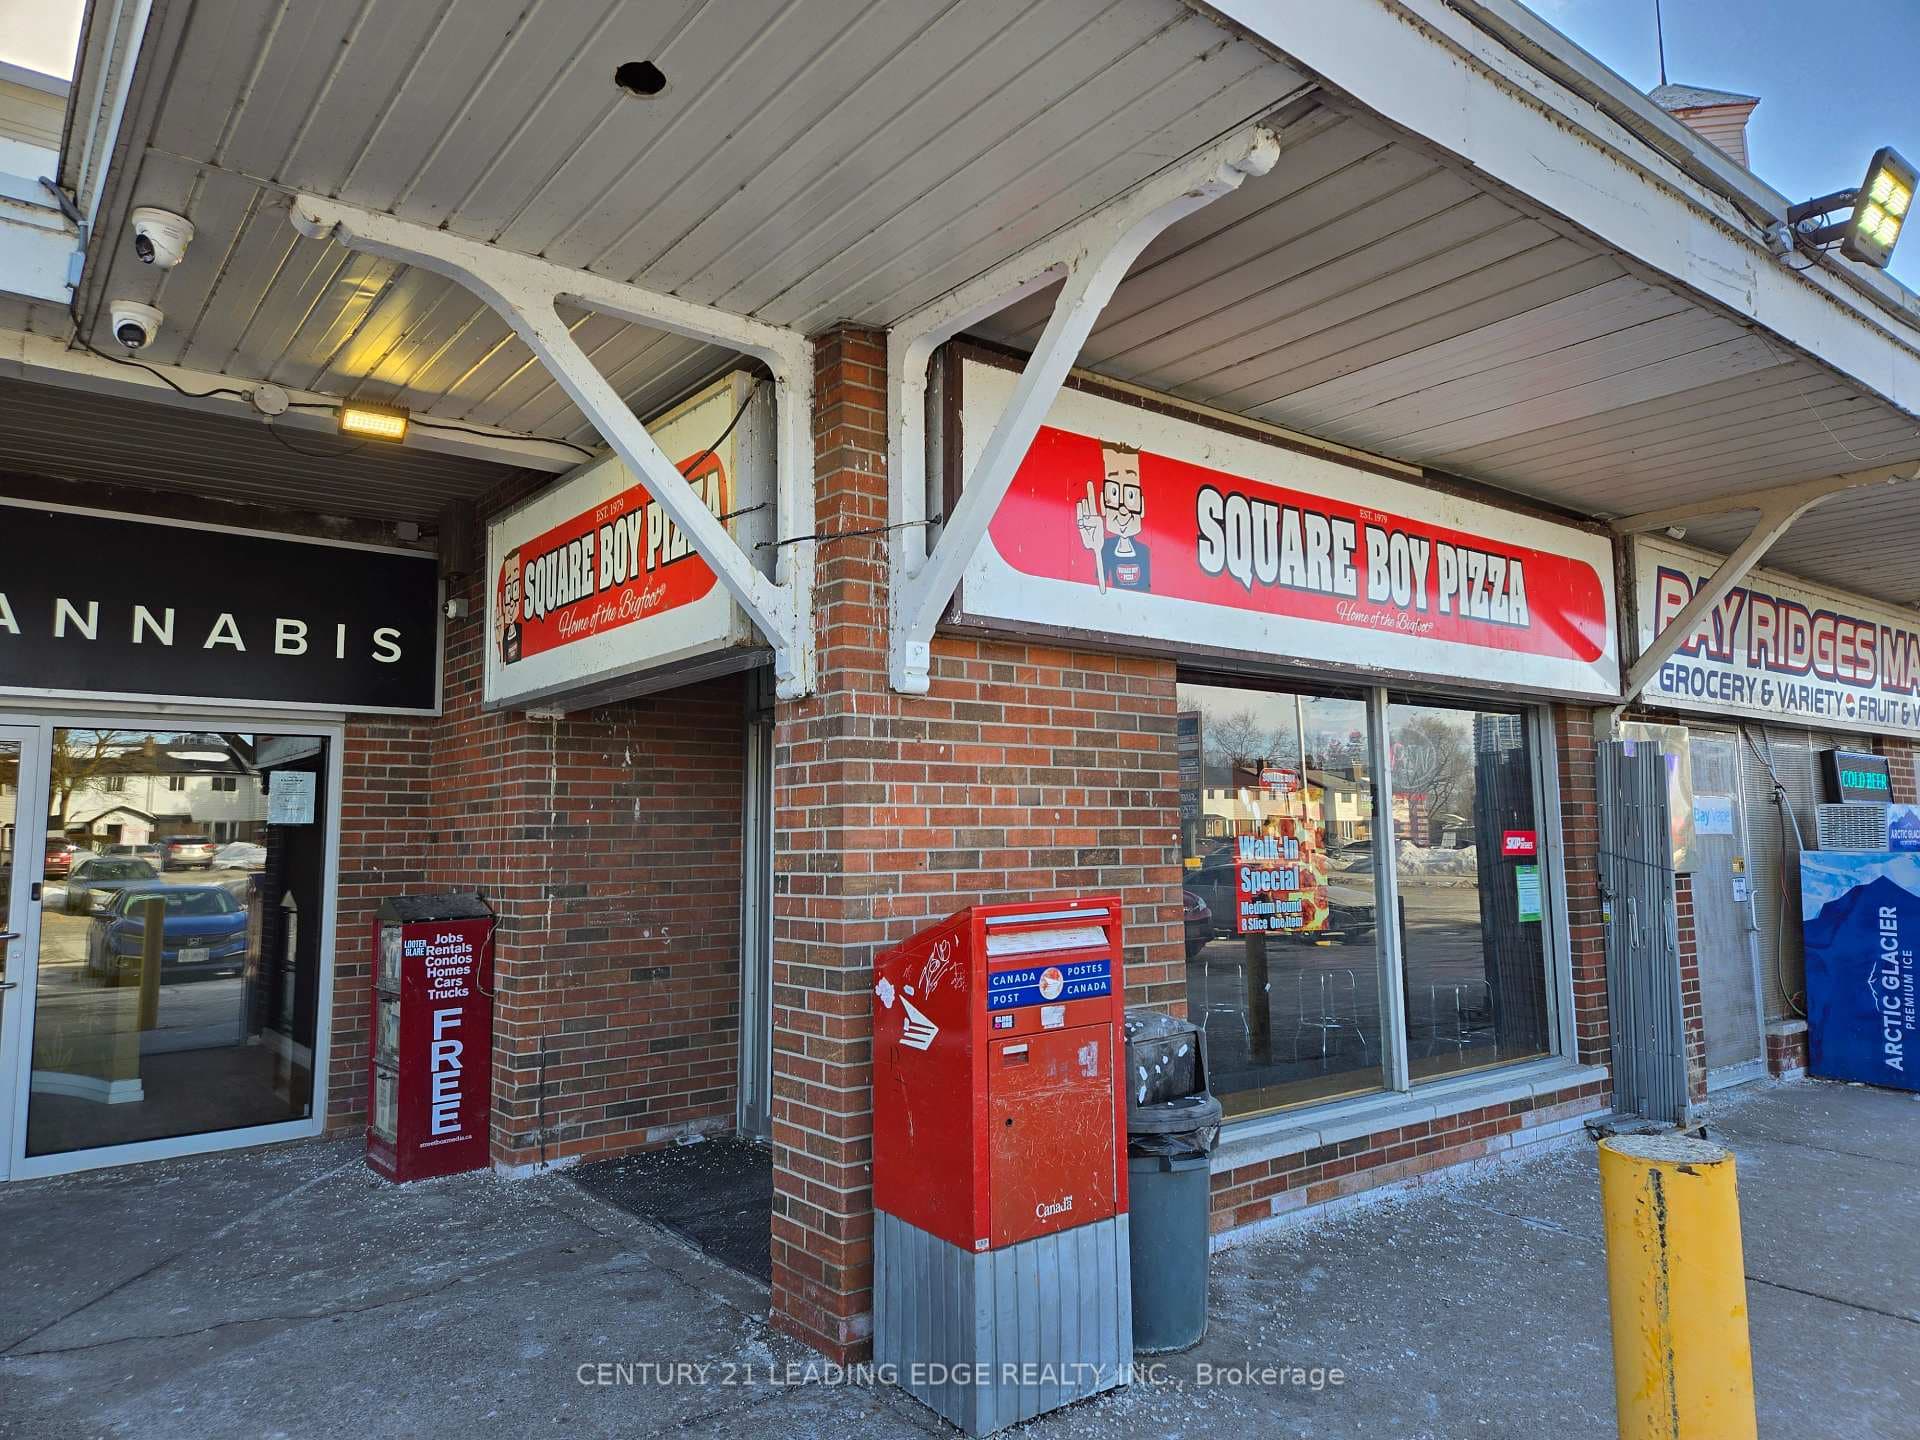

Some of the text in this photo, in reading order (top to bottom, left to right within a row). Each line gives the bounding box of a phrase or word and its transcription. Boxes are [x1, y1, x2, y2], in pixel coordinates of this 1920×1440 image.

[596, 498, 625, 523] EST. 1979
[1374, 512, 1388, 524] 1979
[523, 469, 722, 624] SQUARE BOY PIA
[1197, 484, 1530, 629] SQUARE BOY PIZZA
[559, 607, 588, 639] Home
[589, 604, 601, 634] of
[600, 602, 617, 625] the
[1336, 600, 1369, 622] Home
[1370, 611, 1381, 628] of
[1380, 615, 1395, 627] the
[1747, 589, 1877, 689] RIDGES
[1660, 662, 1757, 704] GROCERY
[1761, 679, 1774, 706] &
[1777, 681, 1844, 716] VARIETY
[1858, 696, 1898, 724] FRUIT
[1902, 702, 1911, 725] &
[1841, 770, 1865, 788] COLD
[1238, 836, 1299, 861] Walk-In
[1240, 866, 1300, 894] Special
[1240, 899, 1303, 916] Medium Round
[1248, 918, 1268, 931] Slice
[434, 933, 464, 944] Jobs
[425, 943, 473, 956] Rentals
[425, 954, 473, 967] Condos
[1067, 963, 1103, 976] POSTES
[426, 965, 471, 978] Homes
[992, 972, 1036, 986] CANADA
[434, 977, 463, 988] Cars
[1067, 981, 1107, 994] CANADA
[1878, 905, 1904, 1072] ARCTIC GLACIER
[1902, 949, 1916, 1030] PREMIUM ICE
[427, 986, 469, 1000] Trucks
[993, 993, 1020, 1005] POST
[430, 1007, 464, 1136] FREE
[1036, 1195, 1073, 1218] Canada
